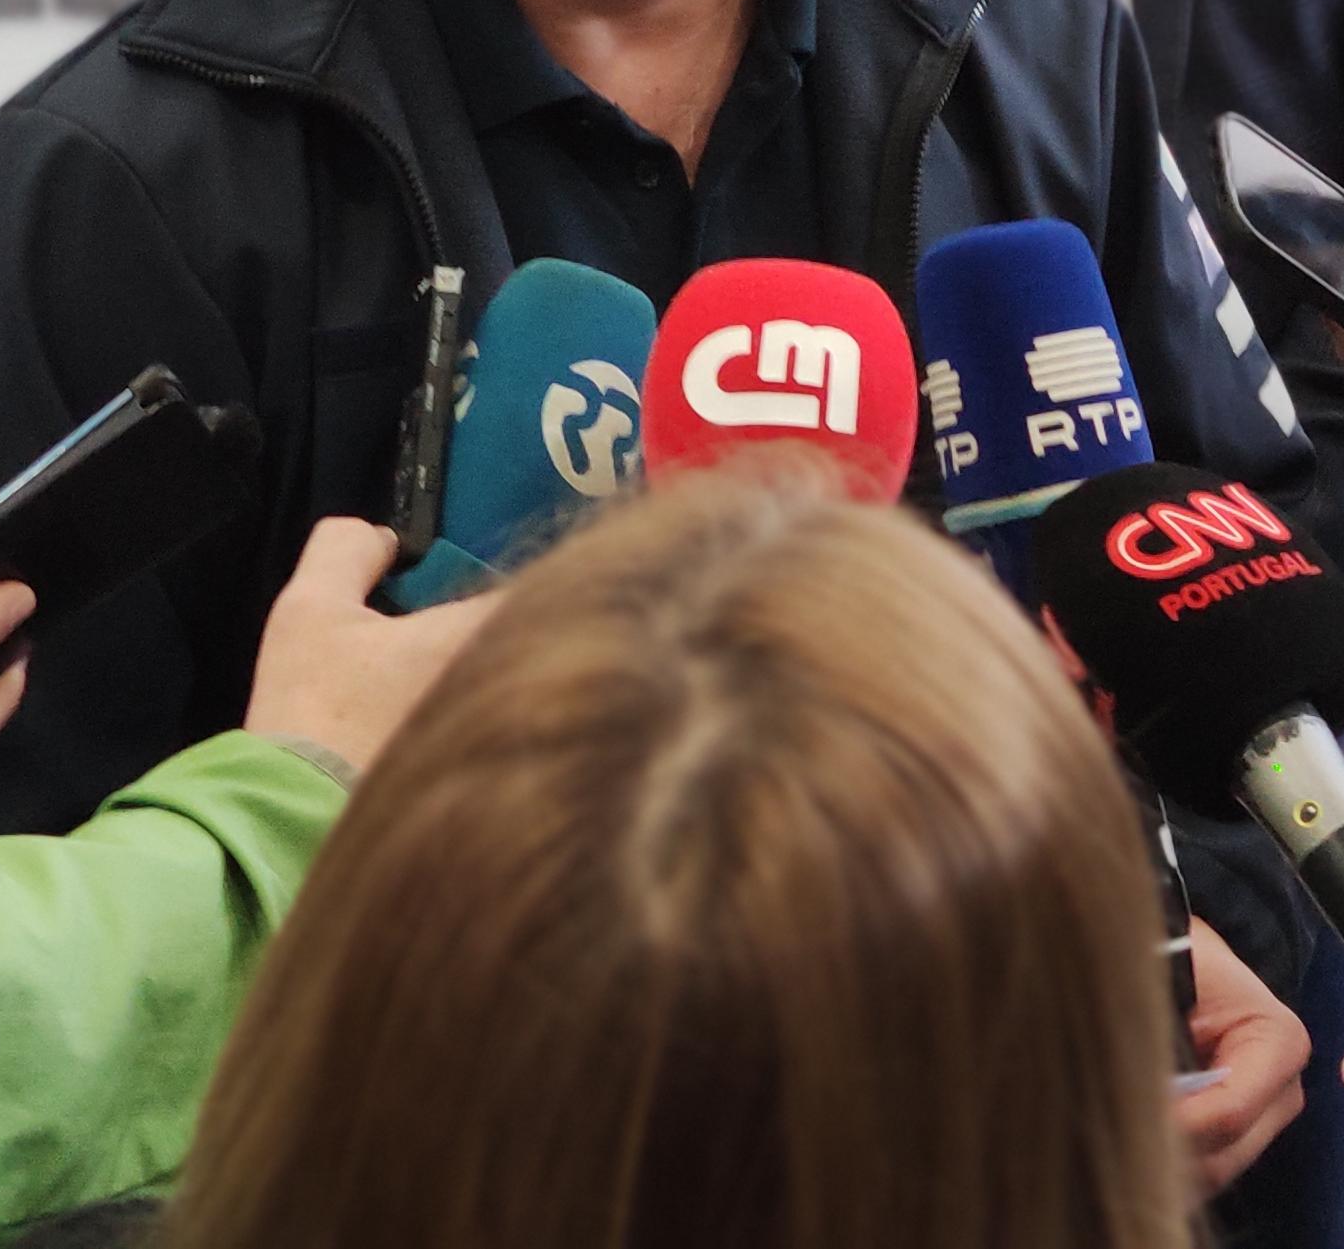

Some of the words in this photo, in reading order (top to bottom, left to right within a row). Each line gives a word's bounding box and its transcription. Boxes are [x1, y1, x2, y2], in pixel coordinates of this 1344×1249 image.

[934, 431, 979, 480] TP
[1026, 398, 1142, 458] RTP
[1105, 482, 1292, 580] CNN
[1158, 551, 1323, 622] PORTUGAL
